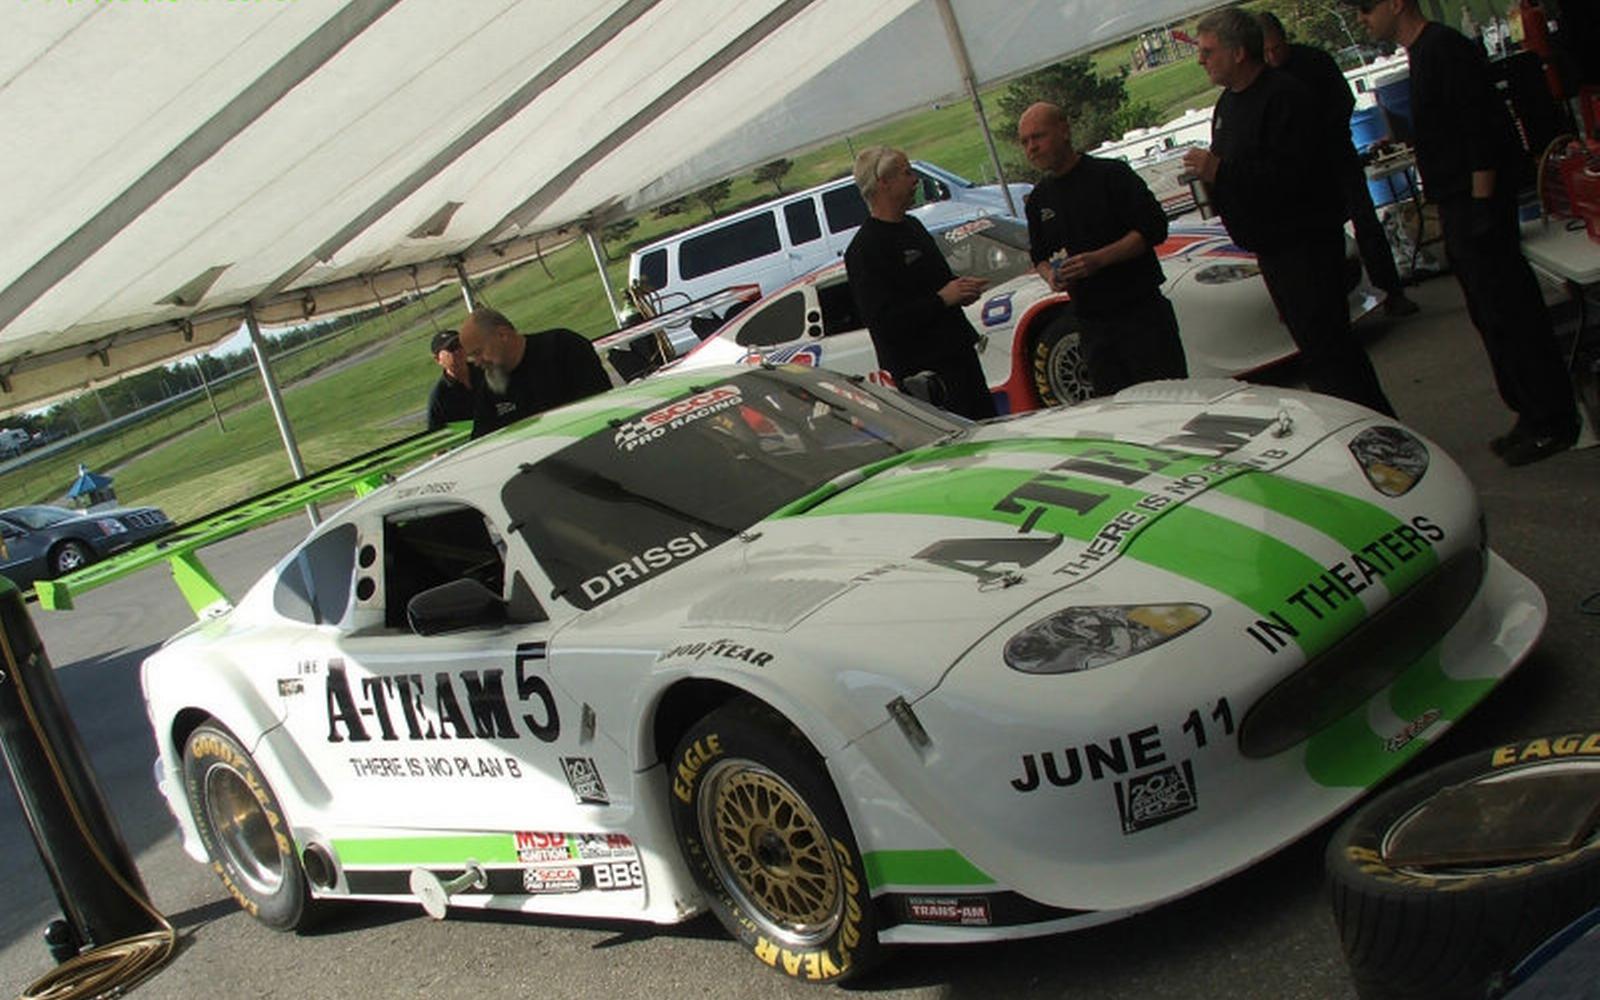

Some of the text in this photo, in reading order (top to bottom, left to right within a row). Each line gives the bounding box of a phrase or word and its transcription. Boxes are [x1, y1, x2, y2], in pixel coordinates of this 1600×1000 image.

[626, 396, 743, 451] PRO RACING
[1053, 510, 1146, 578] THERE
[1135, 493, 1172, 513] IS
[1165, 471, 1209, 496] NO
[580, 531, 709, 601] DRISSI
[1246, 515, 1446, 655] IN THEATERS
[326, 657, 520, 742] A-TEAM
[515, 641, 561, 743] 5
[349, 757, 522, 779] THERE IS NO PLAN B
[672, 733, 724, 805] EAGLE
[1010, 696, 1234, 793] JUNE 11
[515, 830, 566, 849] MSD
[537, 868, 577, 880] SCCA
[911, 904, 986, 919] TRANS-AM
